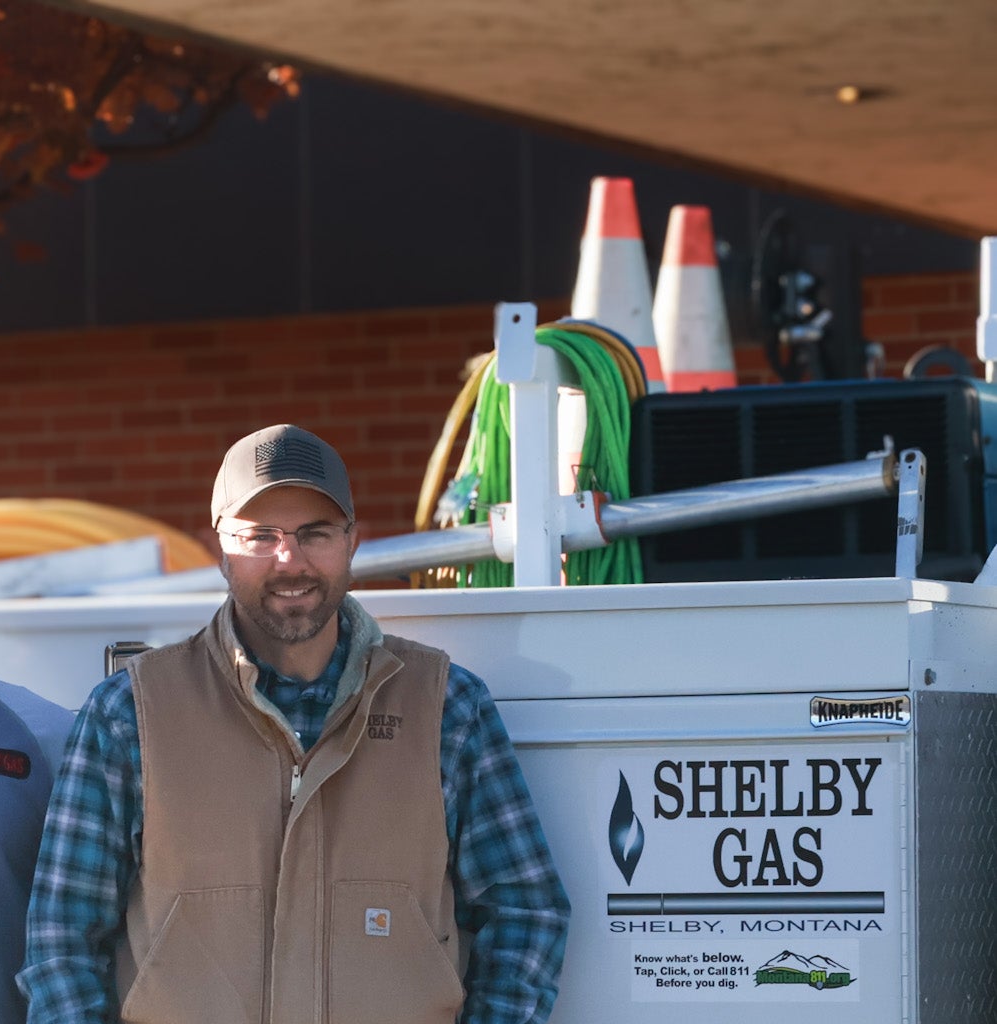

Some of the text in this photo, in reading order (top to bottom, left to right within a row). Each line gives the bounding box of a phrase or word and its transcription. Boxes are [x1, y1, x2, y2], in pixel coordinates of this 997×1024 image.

[817, 700, 904, 722] KNAPHEIDE
[368, 727, 394, 740] GAS
[653, 757, 882, 820] SHELBY
[712, 826, 824, 888] GAS
[609, 919, 883, 934] SHELBY, MONTANA
[634, 952, 744, 963] Know what's below.
[634, 966, 750, 977] Tap, Click, or Call 811
[656, 978, 738, 990] Before you dig.
